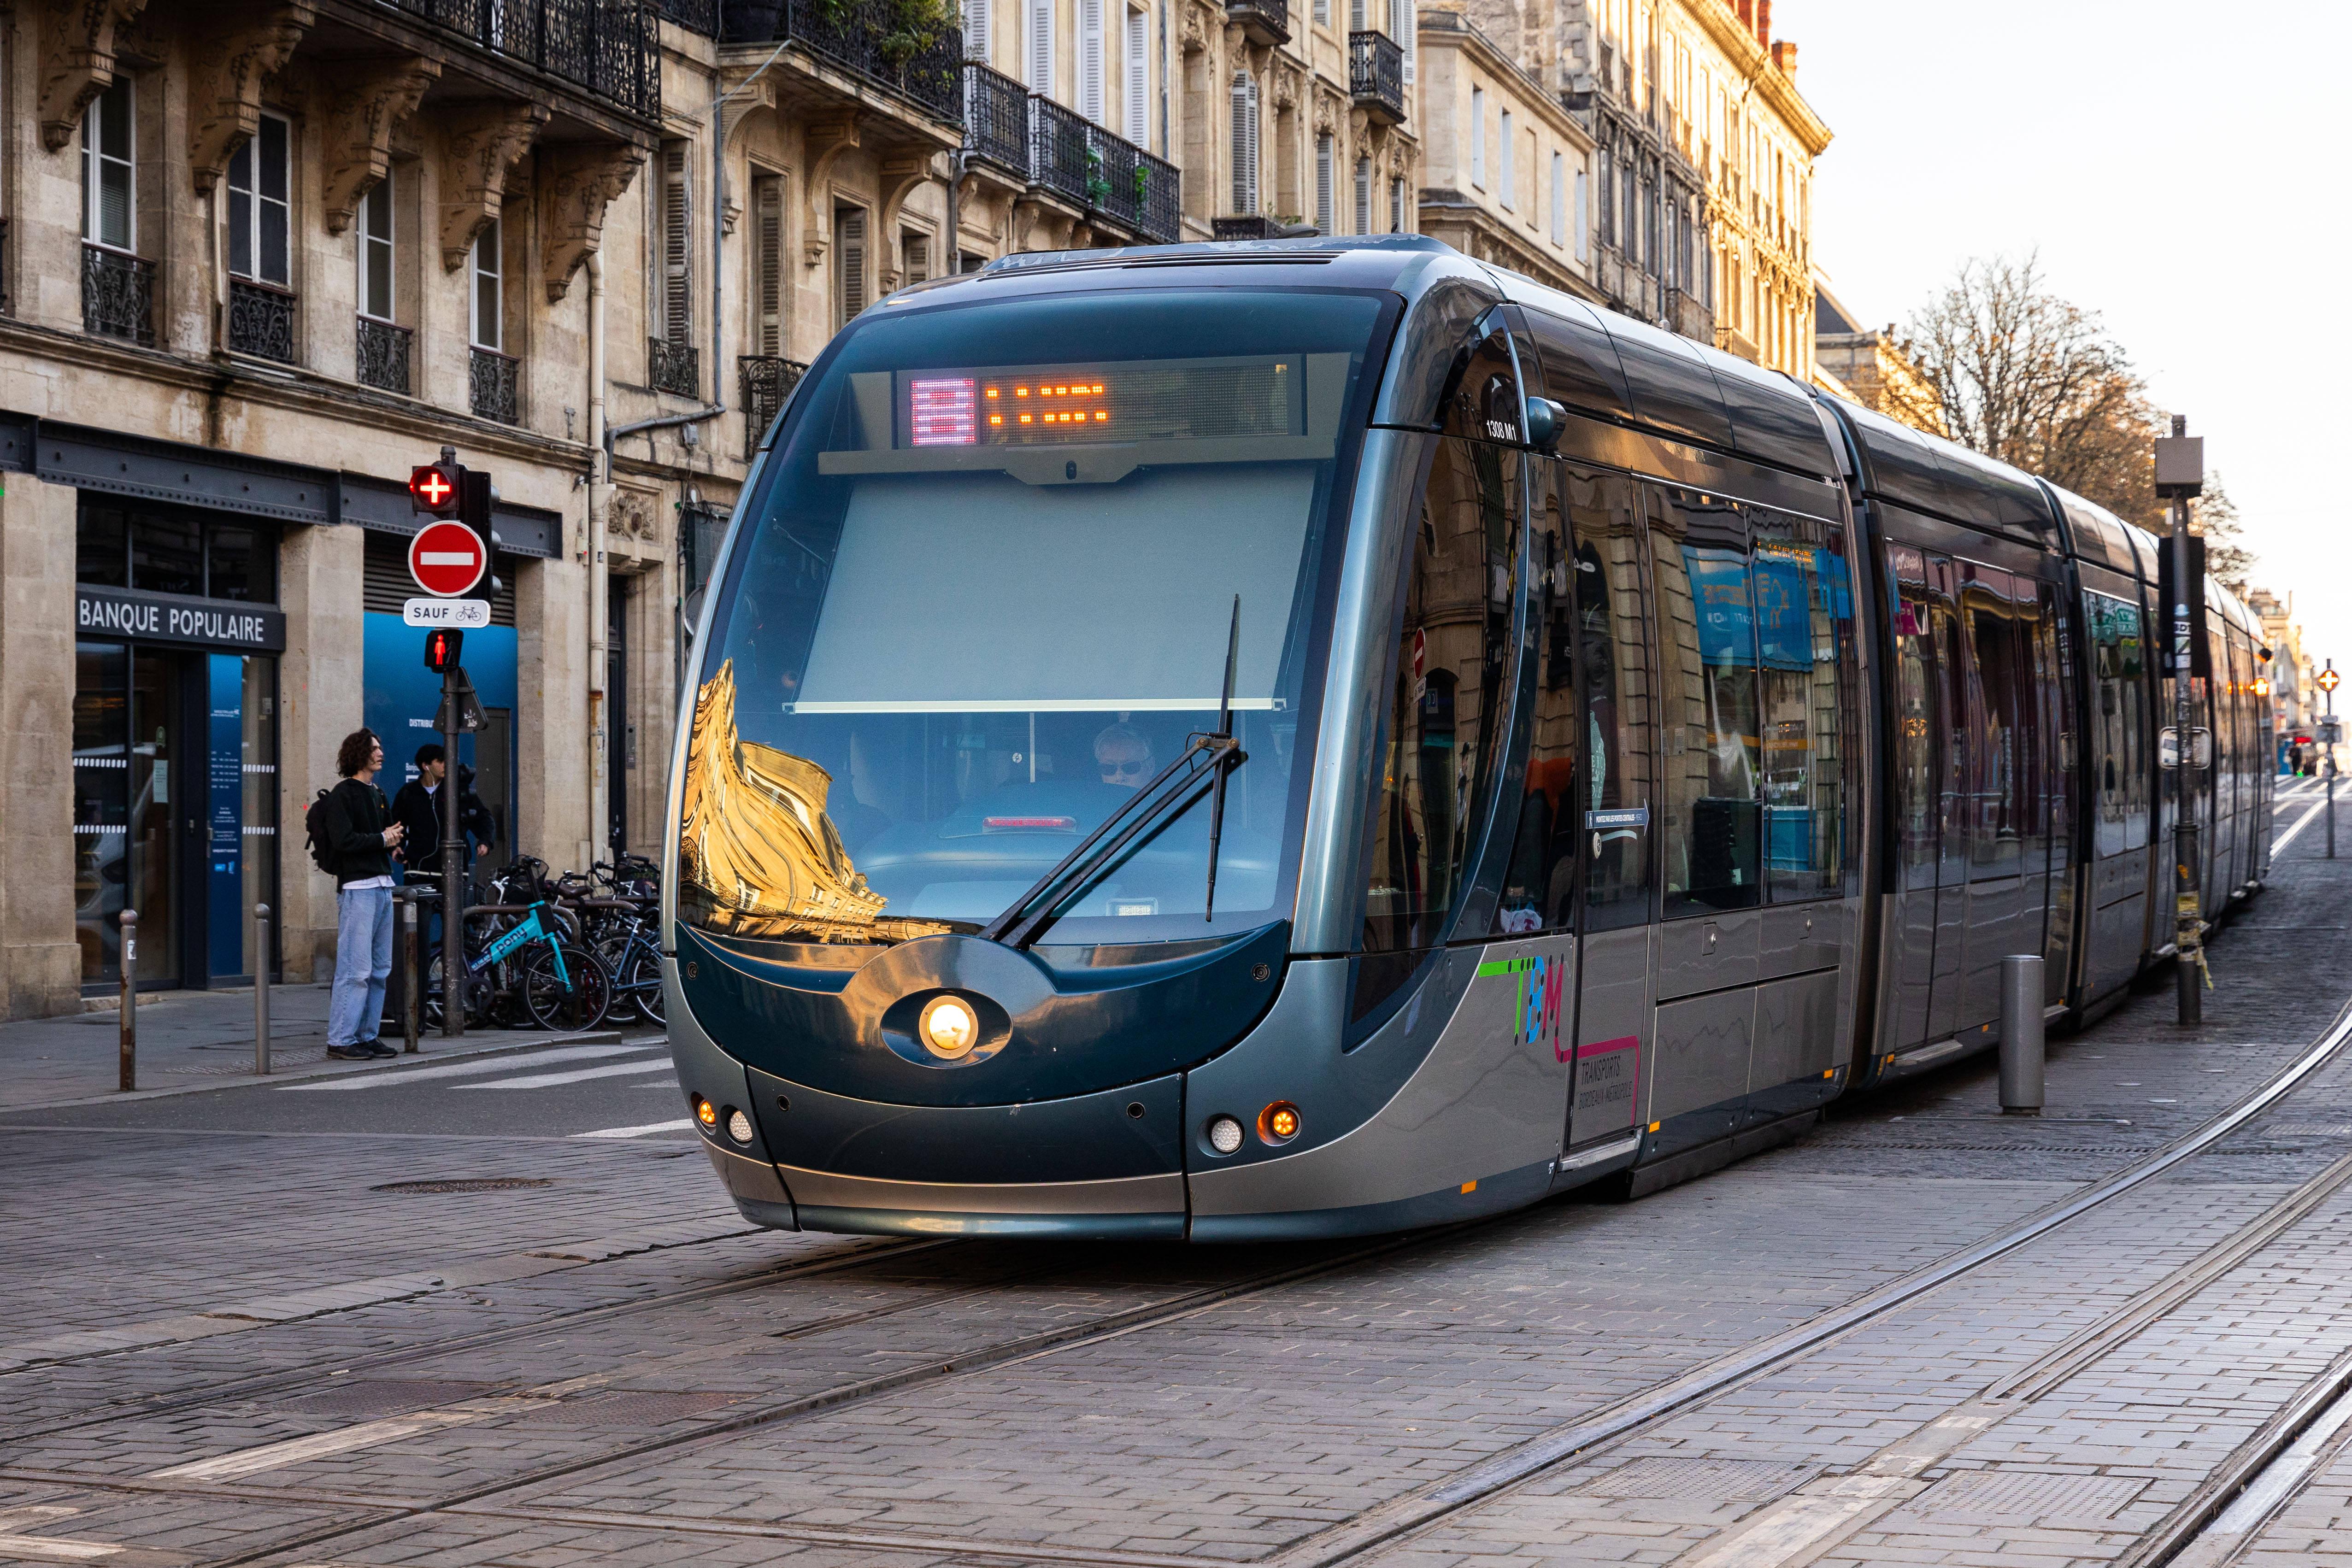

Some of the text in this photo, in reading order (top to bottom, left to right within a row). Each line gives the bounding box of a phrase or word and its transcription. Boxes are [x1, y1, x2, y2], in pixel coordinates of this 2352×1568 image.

[1487, 420, 1517, 441] 1308 M1
[80, 600, 264, 642] BANQUE POPULAIRE
[414, 608, 449, 618] SAUF
[496, 927, 528, 955] pony
[1479, 953, 1564, 1046] TBM
[1582, 1055, 1621, 1085] TRANSPORTS
[1579, 1081, 1633, 1110] BORDEAUX MÉTROPOLE
